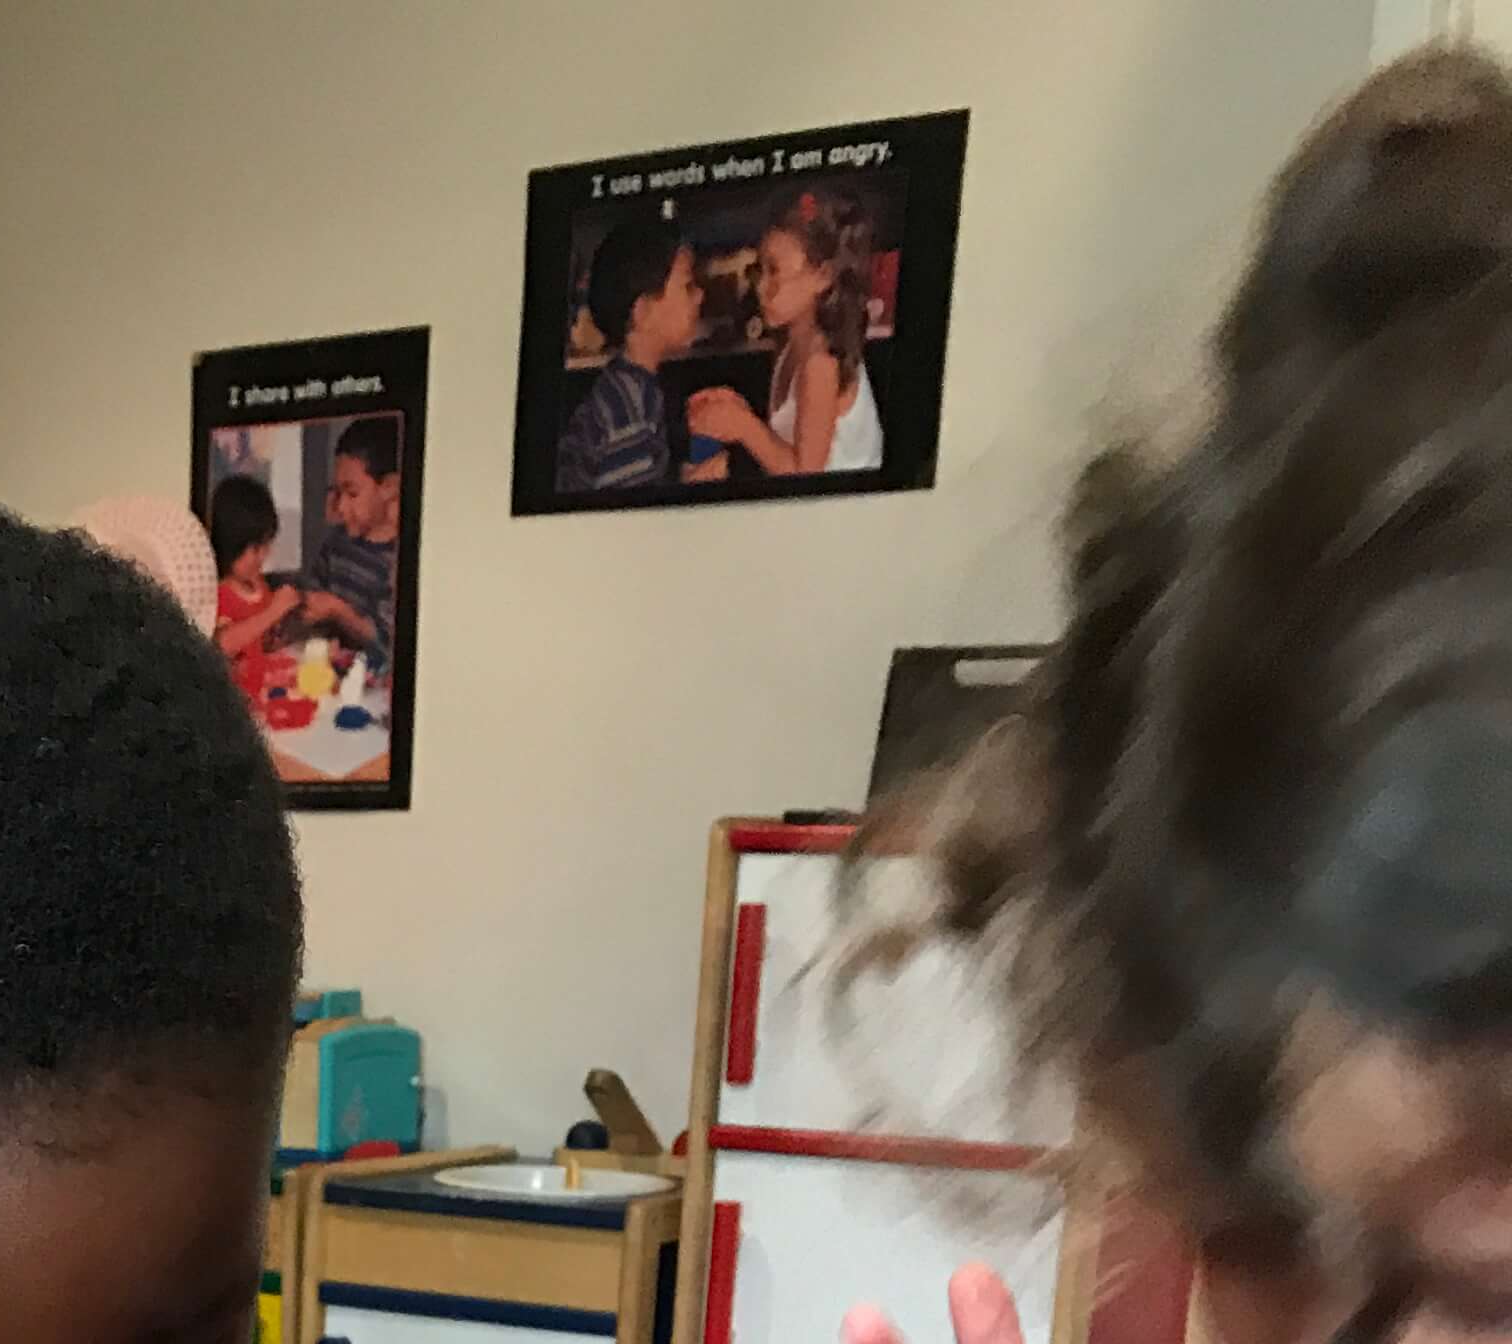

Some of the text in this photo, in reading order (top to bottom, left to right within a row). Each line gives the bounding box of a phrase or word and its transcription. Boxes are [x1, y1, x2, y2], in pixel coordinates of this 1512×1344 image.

[591, 140, 893, 198] I use words when I am angry.
[228, 374, 385, 408] I share with others.
